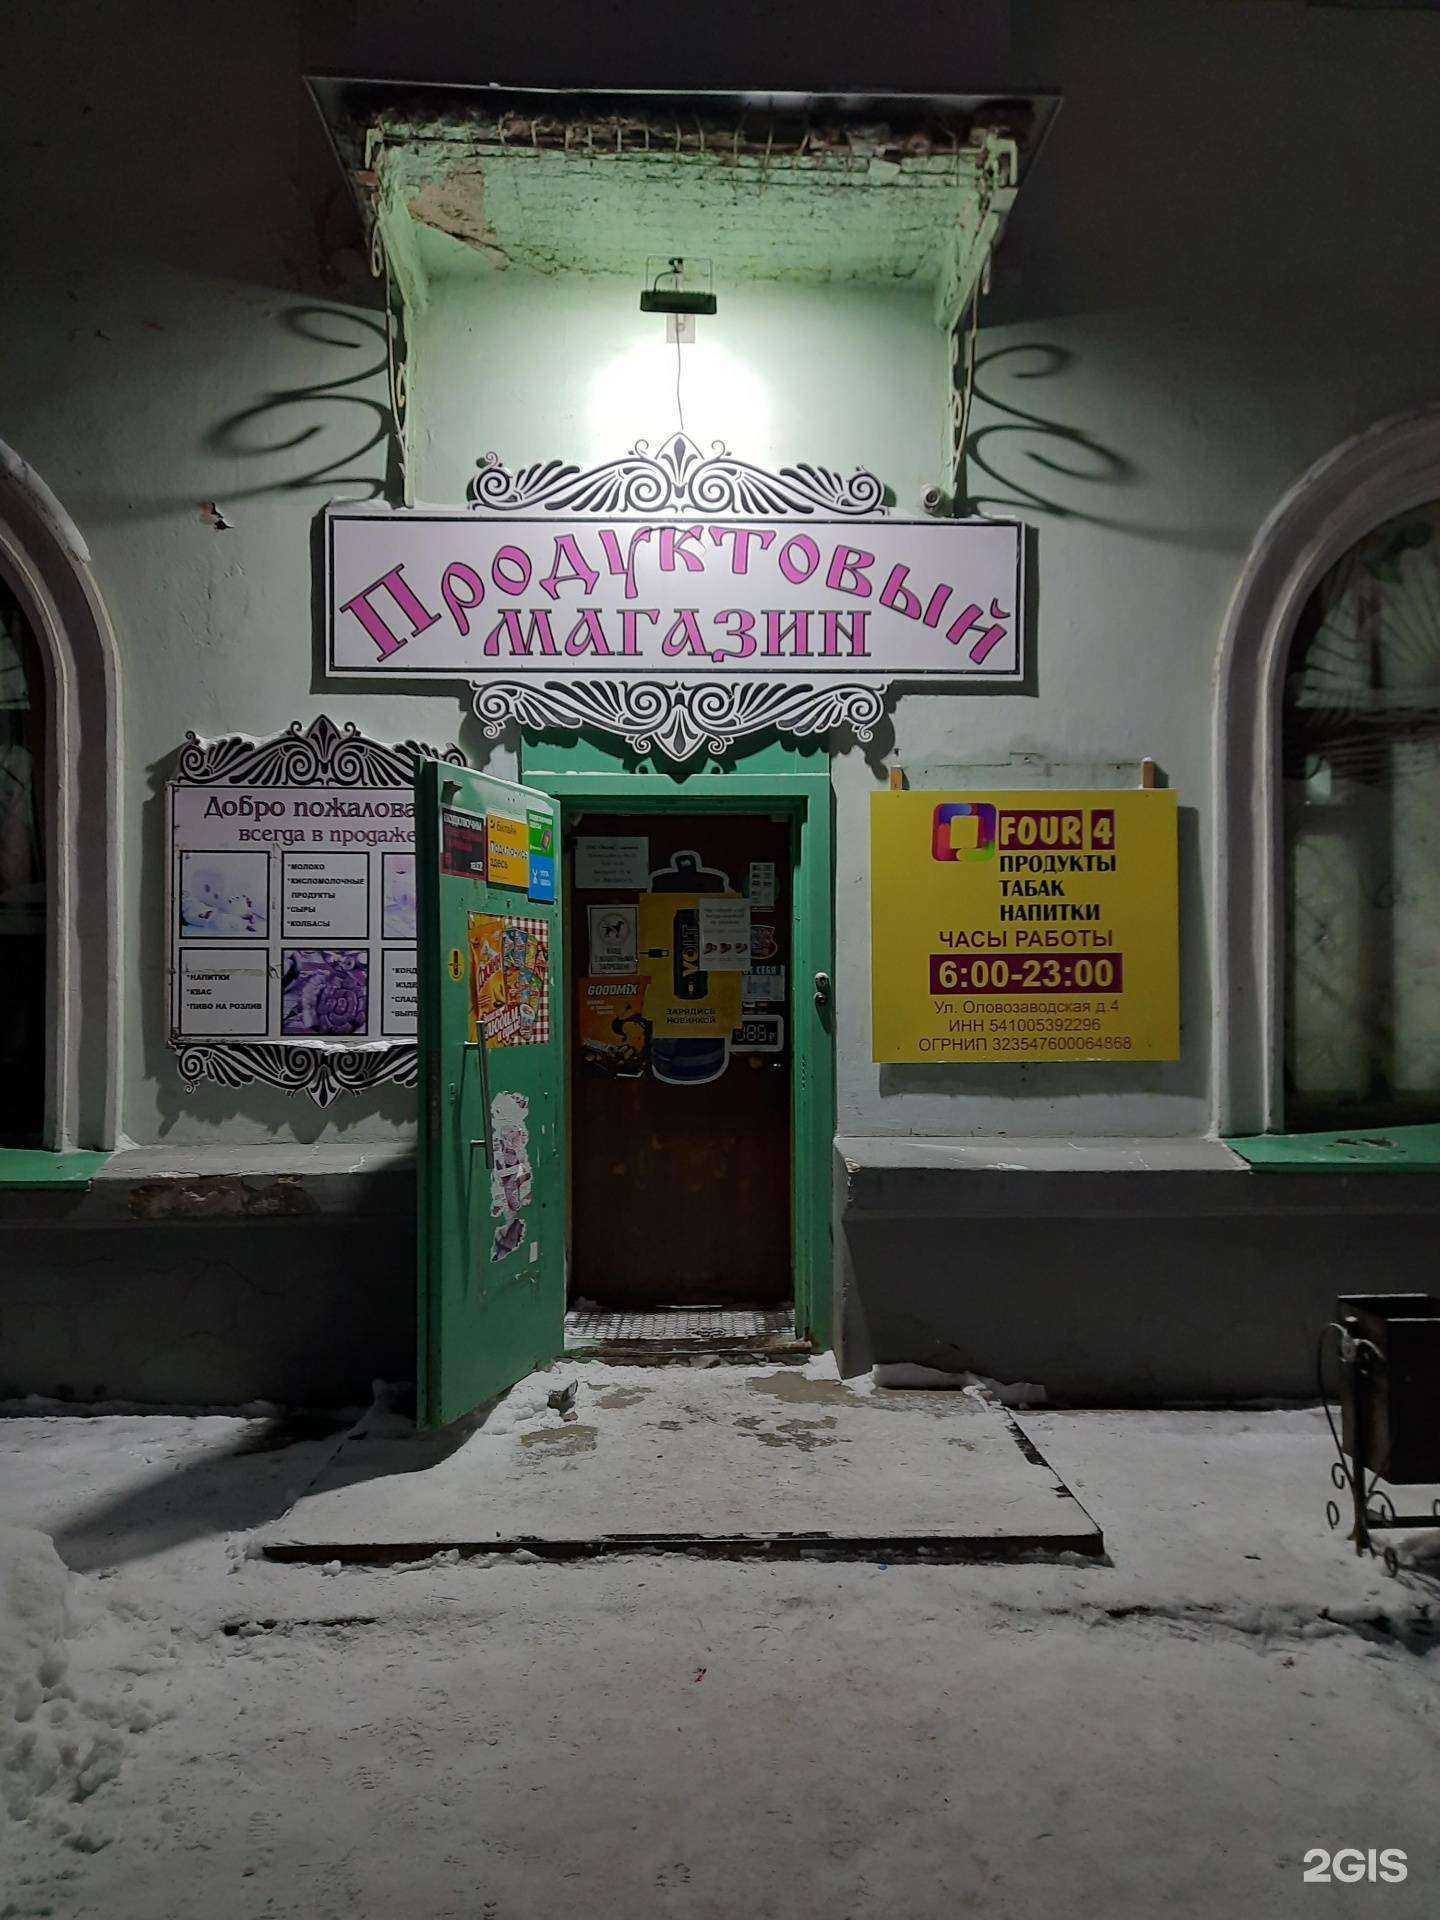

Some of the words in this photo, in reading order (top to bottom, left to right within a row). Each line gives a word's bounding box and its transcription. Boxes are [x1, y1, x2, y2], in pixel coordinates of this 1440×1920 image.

[203, 795, 286, 822] Добро
[238, 828, 305, 846] всегда
[311, 828, 324, 842] в
[329, 827, 416, 847] продаже
[1001, 815, 1082, 846] FOUR
[1092, 817, 1113, 846] 4
[1000, 854, 1116, 873] ПРОДУКТЫ
[291, 892, 336, 900] ПРОДУКТЫ
[1000, 880, 1065, 897] ТАБАК
[1000, 903, 1100, 922] НАПИТКИ
[939, 931, 1007, 948] ЧАСЫ
[1015, 930, 1113, 947] РАБОТЫ
[939, 959, 1114, 988] 6:00-23:00
[934, 1000, 958, 1014] Ул.
[962, 1000, 1090, 1014] Оловозаводская
[948, 1019, 984, 1032] ИНН
[918, 1038, 987, 1052] ОГРНИП
